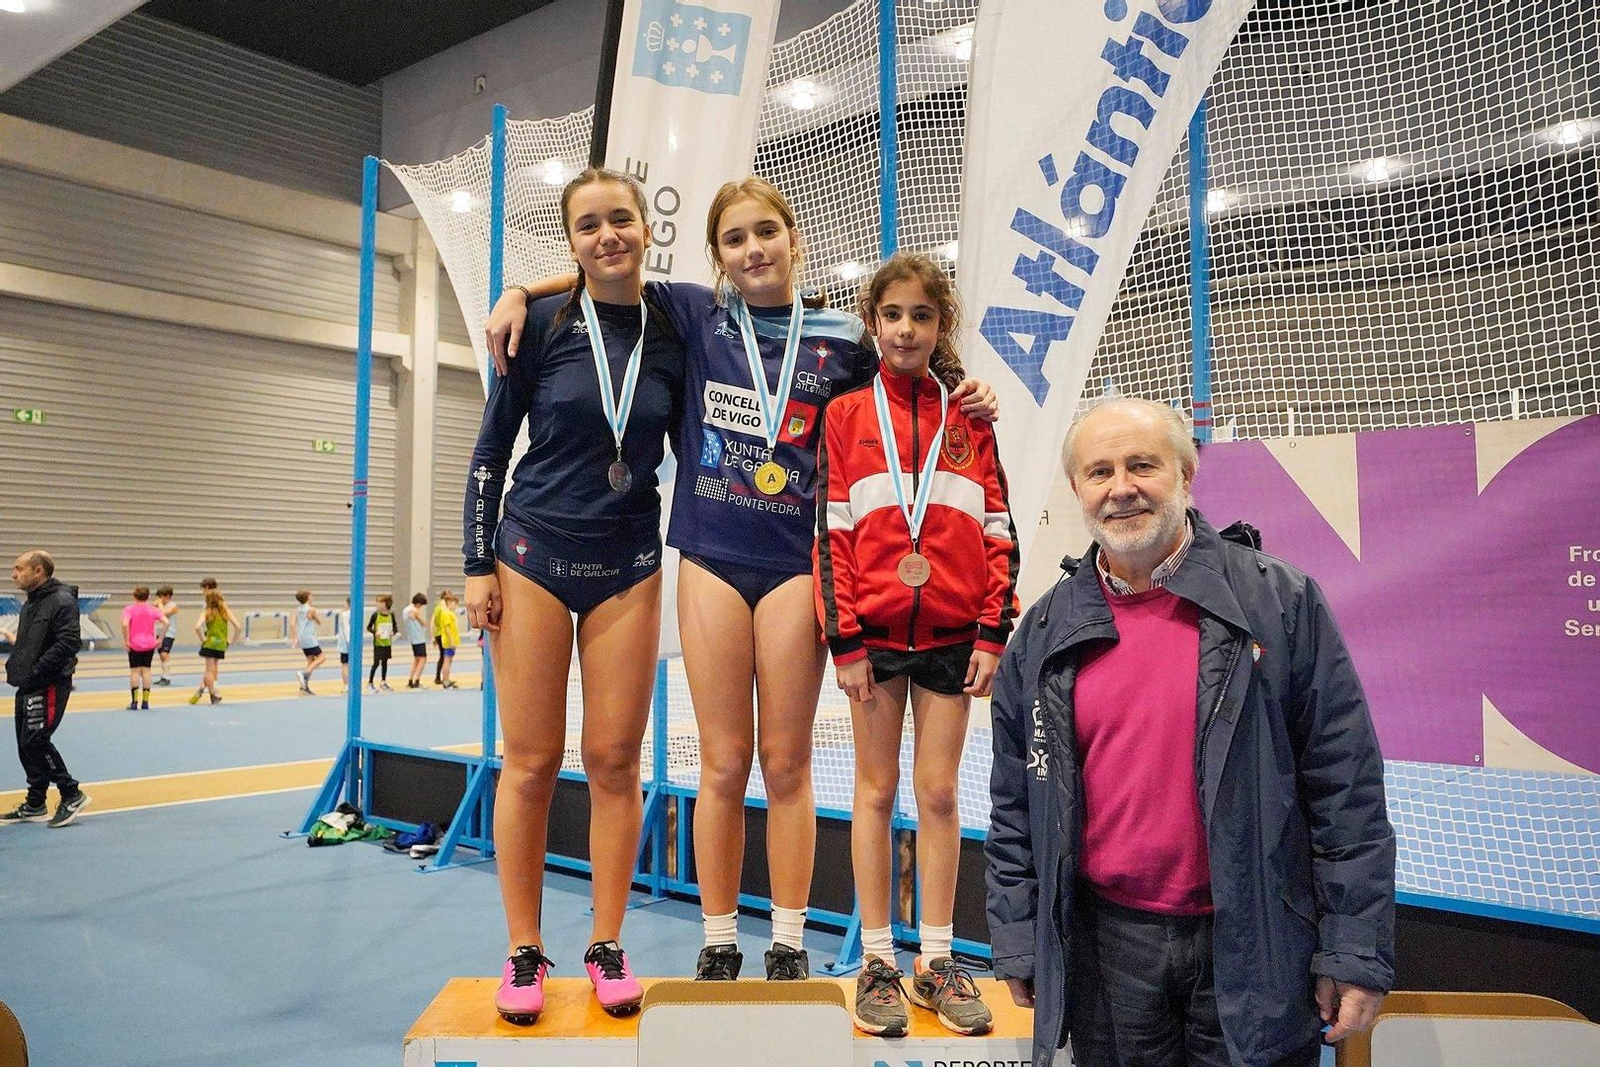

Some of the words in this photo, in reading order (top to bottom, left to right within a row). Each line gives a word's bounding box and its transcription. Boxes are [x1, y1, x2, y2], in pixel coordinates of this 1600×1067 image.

[708, 390, 761, 412] CONCELL
[712, 407, 727, 421] DE
[729, 410, 762, 428] VIGO
[724, 438, 771, 461] XUNTA
[724, 453, 740, 469] DE
[767, 473, 777, 484] A
[728, 493, 801, 517] PONTEVEDRA
[571, 562, 603, 571] XUNTA
[632, 559, 656, 568] ZICO
[583, 568, 620, 578] GALICIA
[1568, 570, 1596, 587] de
